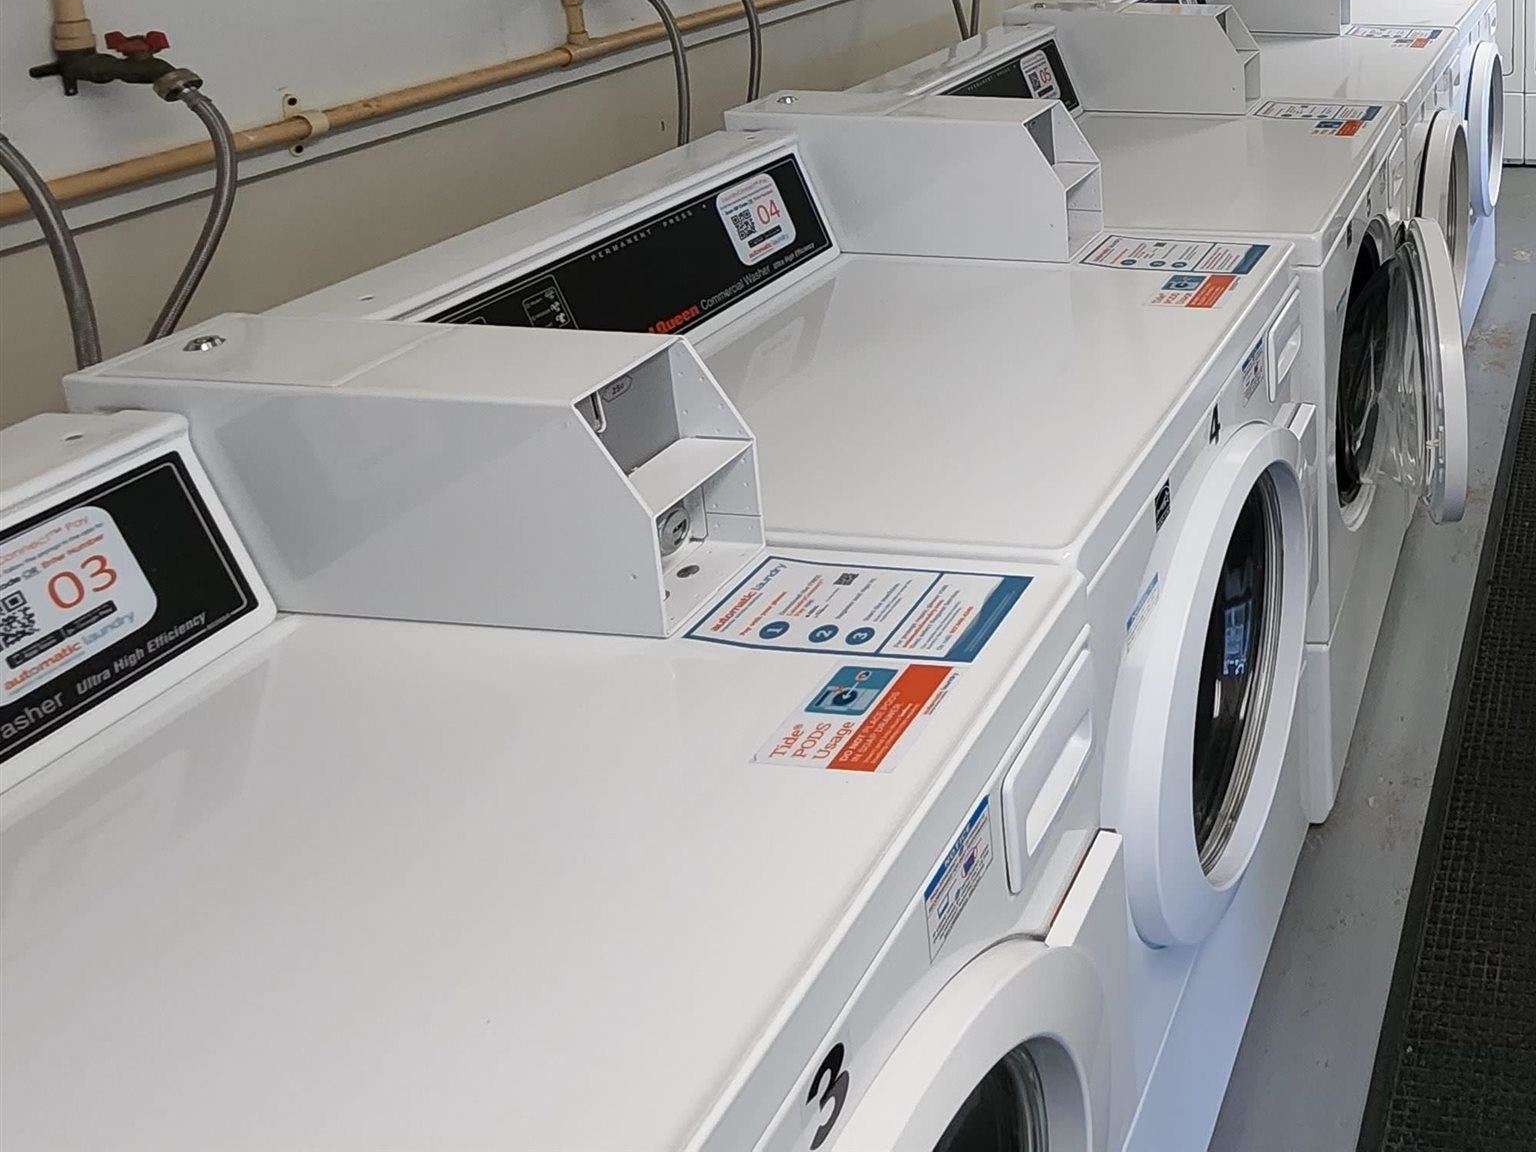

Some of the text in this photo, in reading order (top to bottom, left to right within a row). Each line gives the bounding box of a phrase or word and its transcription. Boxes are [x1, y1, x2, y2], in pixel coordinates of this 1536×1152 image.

[1040, 66, 1052, 84] 05
[662, 209, 693, 227] PRESS
[756, 199, 781, 225] 04
[655, 304, 700, 334] Queen
[700, 279, 744, 311] Commercial
[743, 263, 772, 286] Washer
[1208, 402, 1222, 446] 4
[47, 554, 117, 609] 03
[709, 591, 757, 632] automatic
[754, 562, 787, 592] laundry
[4, 641, 83, 691] automatic
[81, 610, 135, 646] laundry
[0, 690, 65, 741] asher
[76, 667, 112, 696] Ultra
[113, 646, 146, 674] High
[146, 609, 208, 654] Efficiency
[791, 721, 832, 759] PODS
[812, 720, 856, 761] Usage
[837, 749, 854, 761] DO
[846, 733, 867, 749] NOT
[860, 710, 885, 733] PLACE
[848, 753, 863, 762] IN
[855, 732, 879, 753] SOAP
[806, 1041, 850, 1152] 3
